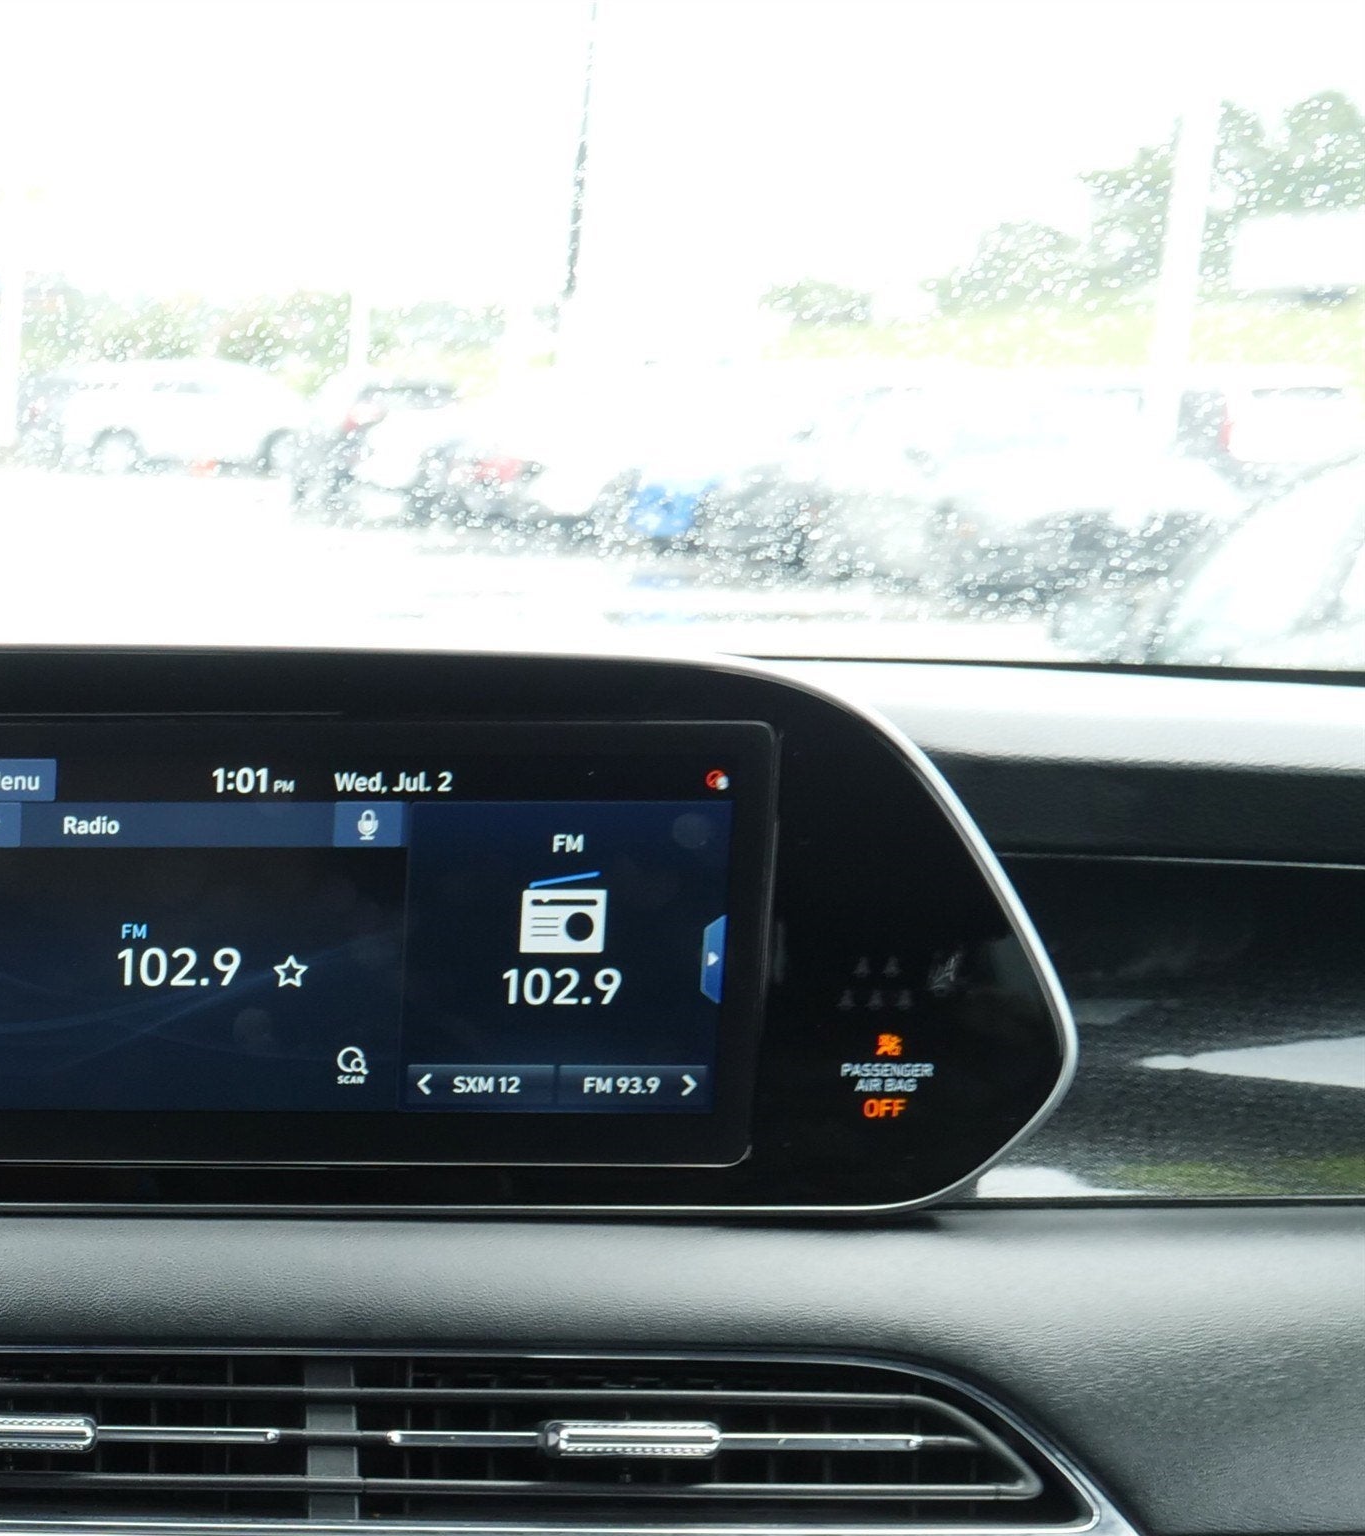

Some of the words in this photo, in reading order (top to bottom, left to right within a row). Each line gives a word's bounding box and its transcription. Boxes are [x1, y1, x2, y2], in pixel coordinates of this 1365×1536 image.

[212, 767, 269, 794] 1:01
[273, 780, 295, 793] PM
[334, 771, 387, 794] Wed,
[392, 770, 431, 792] Jul.
[437, 772, 453, 792] 2
[63, 816, 119, 834] Radio
[552, 834, 583, 852] FM
[121, 924, 147, 939] FM
[117, 947, 242, 987] 102.9
[502, 967, 622, 1006] 102.9
[840, 1062, 934, 1077] PASSENGER
[337, 1075, 365, 1085] SCAN
[452, 1076, 494, 1093] SXM
[498, 1076, 521, 1093] 12
[583, 1076, 612, 1094] FM
[616, 1076, 661, 1094] 93.9
[854, 1078, 883, 1092] AIR
[883, 1078, 918, 1092] BAG
[863, 1098, 907, 1118] OFF
